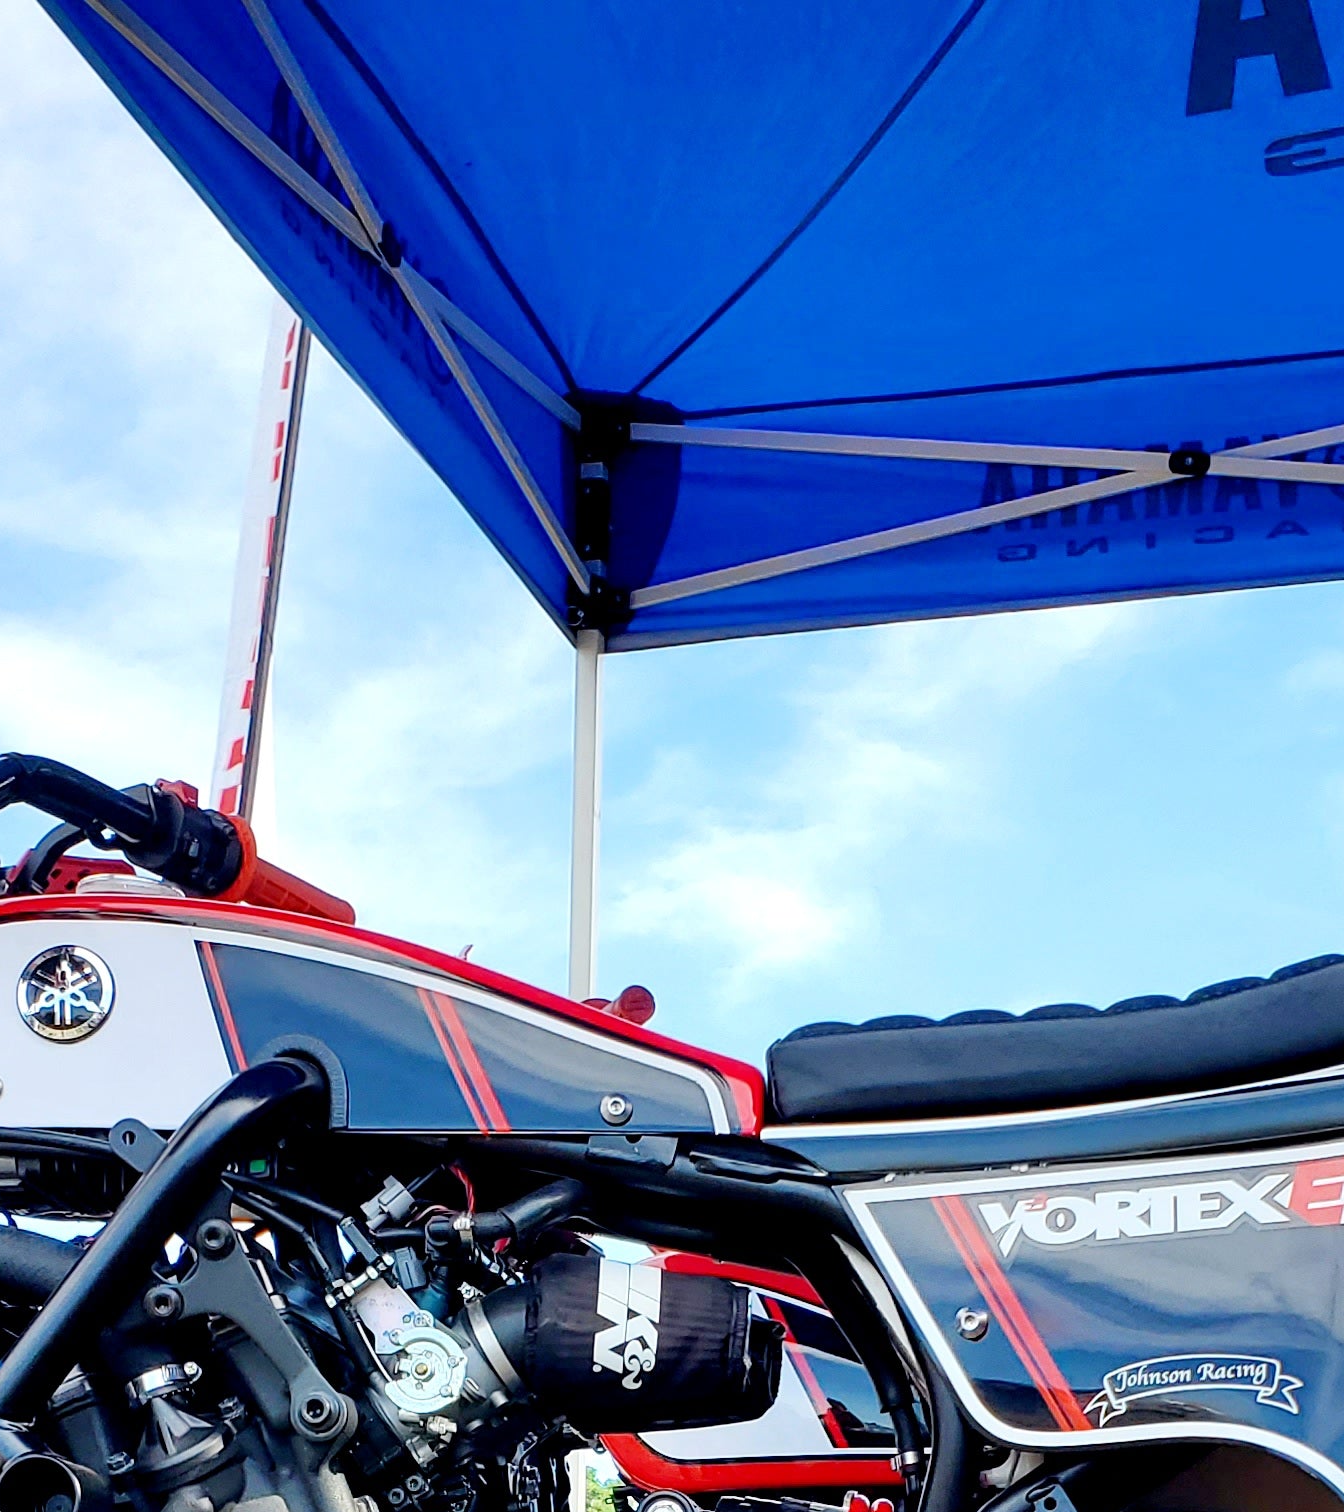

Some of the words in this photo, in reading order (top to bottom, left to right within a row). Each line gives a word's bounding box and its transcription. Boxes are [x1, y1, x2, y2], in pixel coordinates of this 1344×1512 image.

[978, 1172, 1290, 1258] VORTEX
[592, 1257, 662, 1389] K&N
[1115, 1365, 1192, 1392] Johnson
[1196, 1362, 1267, 1384] Racing
